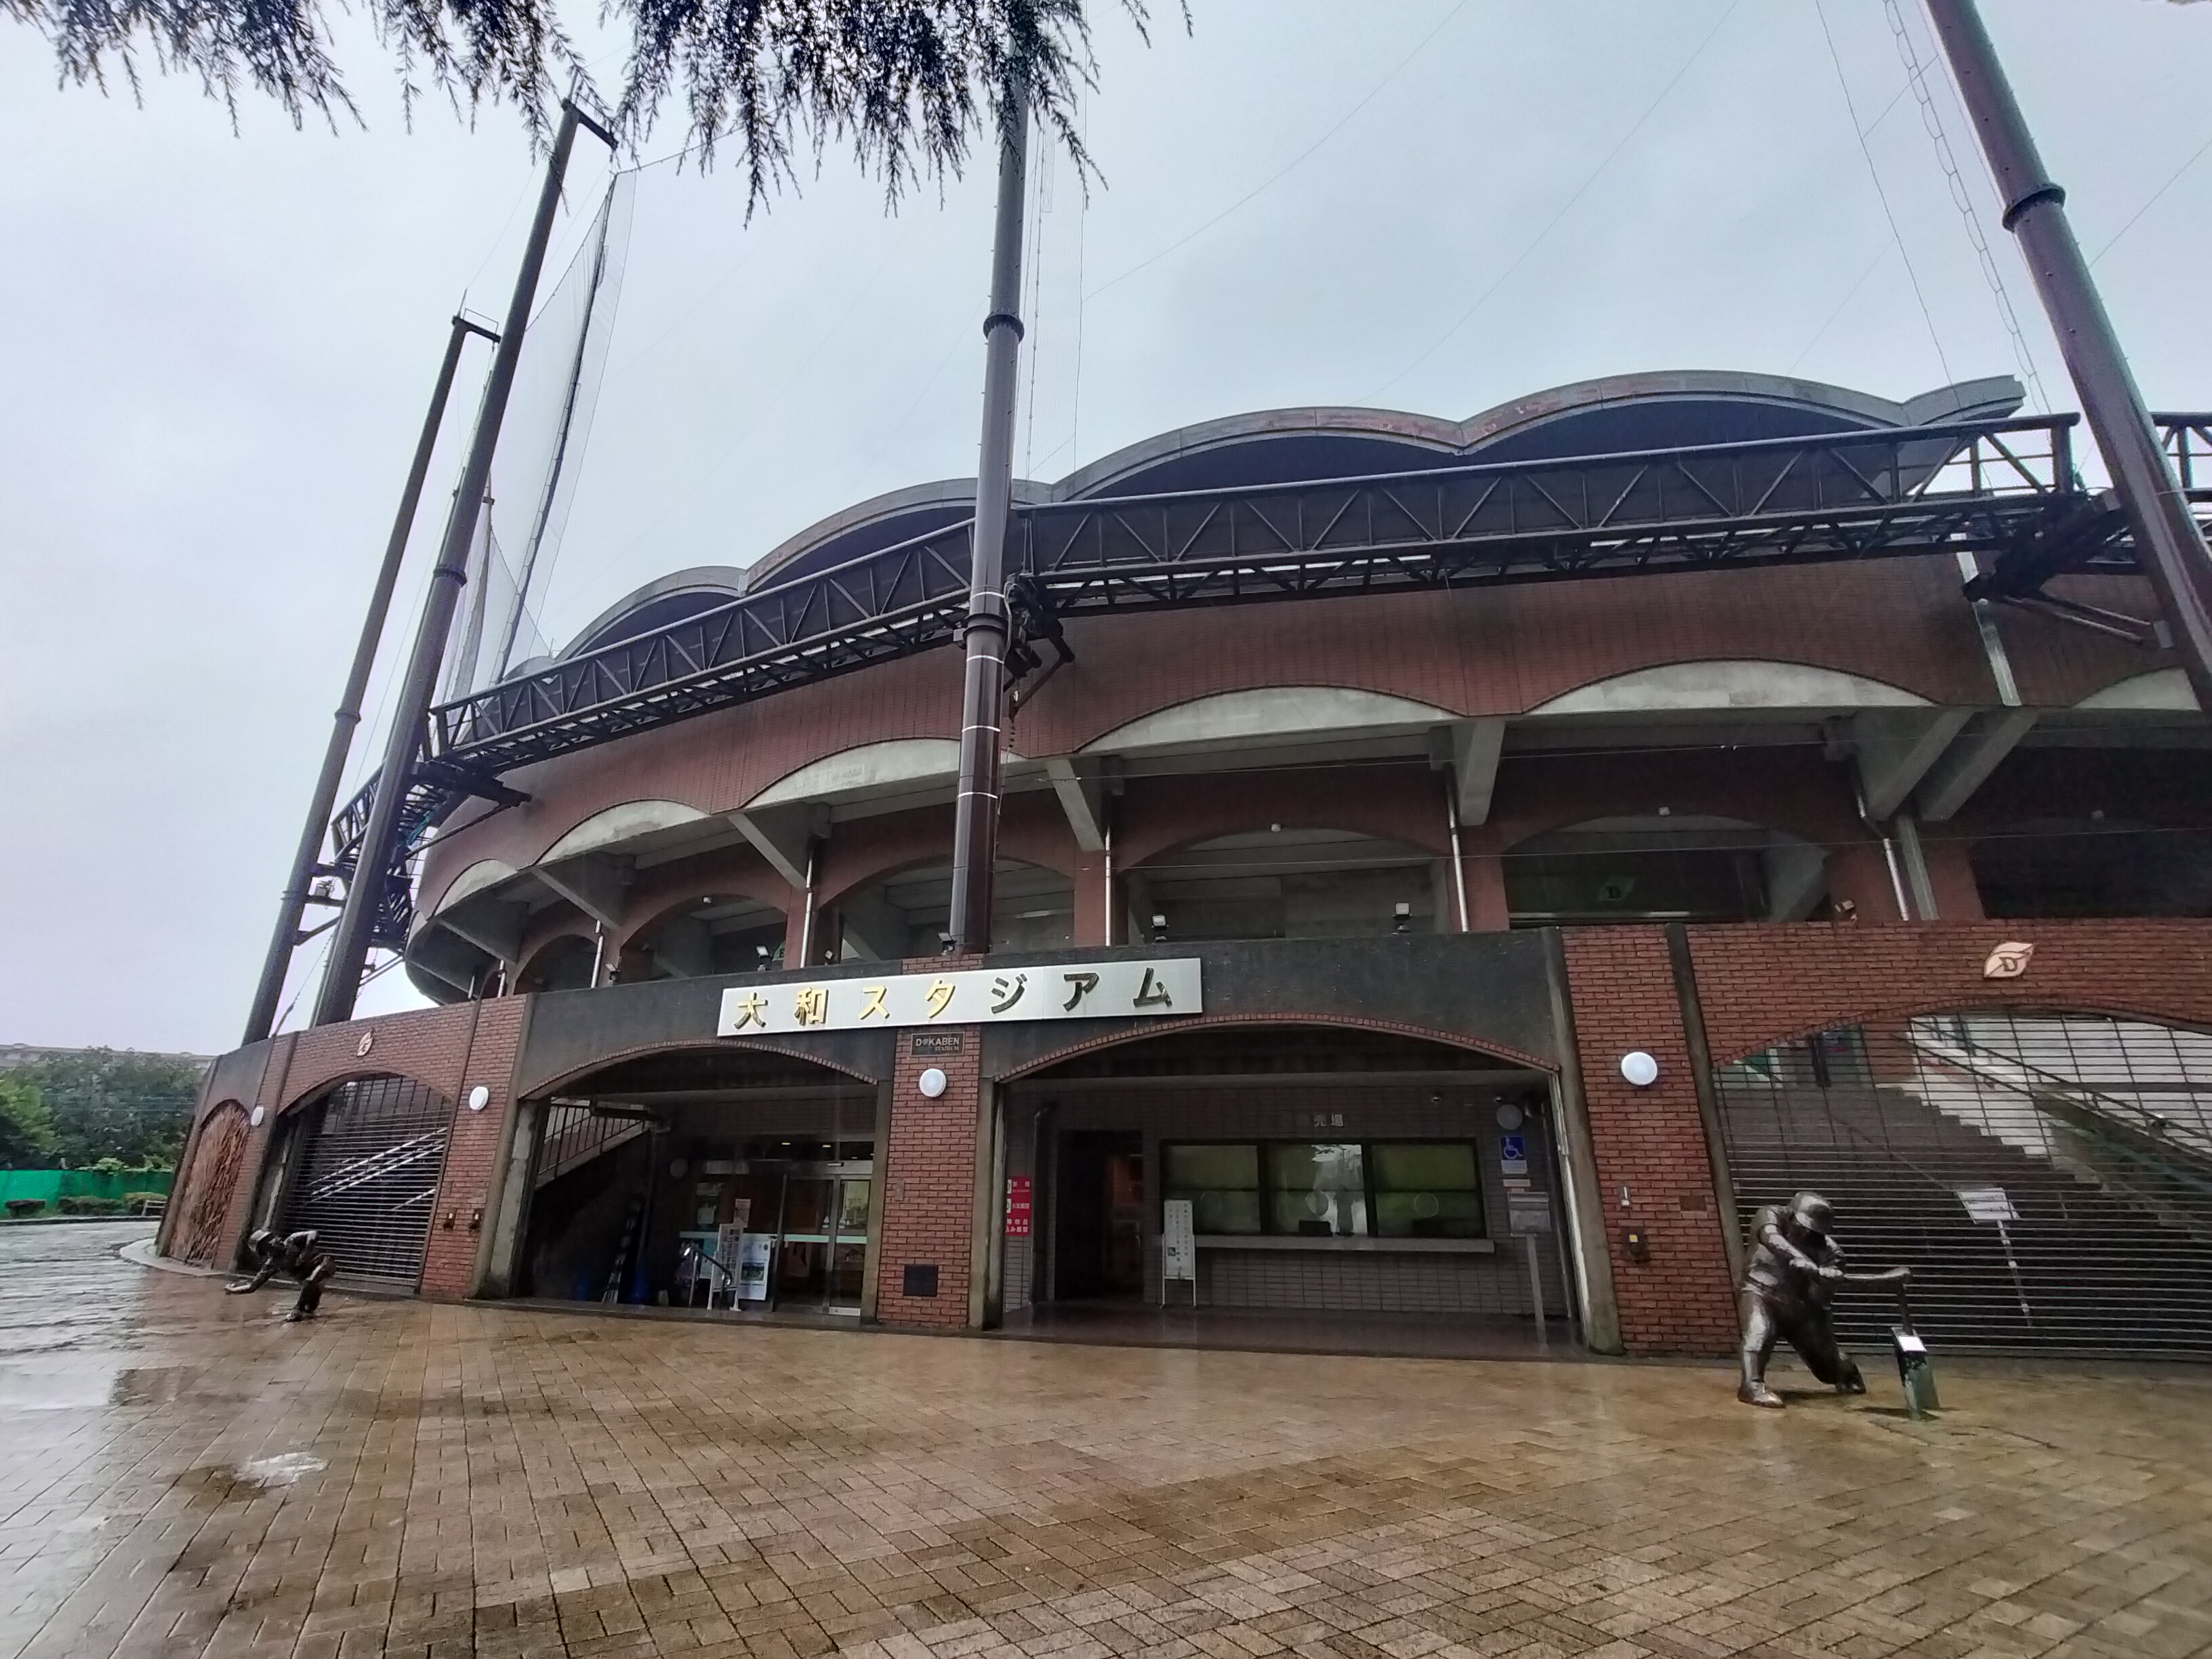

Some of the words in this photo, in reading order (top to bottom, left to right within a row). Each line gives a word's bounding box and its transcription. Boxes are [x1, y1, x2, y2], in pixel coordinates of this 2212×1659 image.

[1999, 956, 2018, 972] D
[733, 967, 1172, 1028] 大和スタジアム
